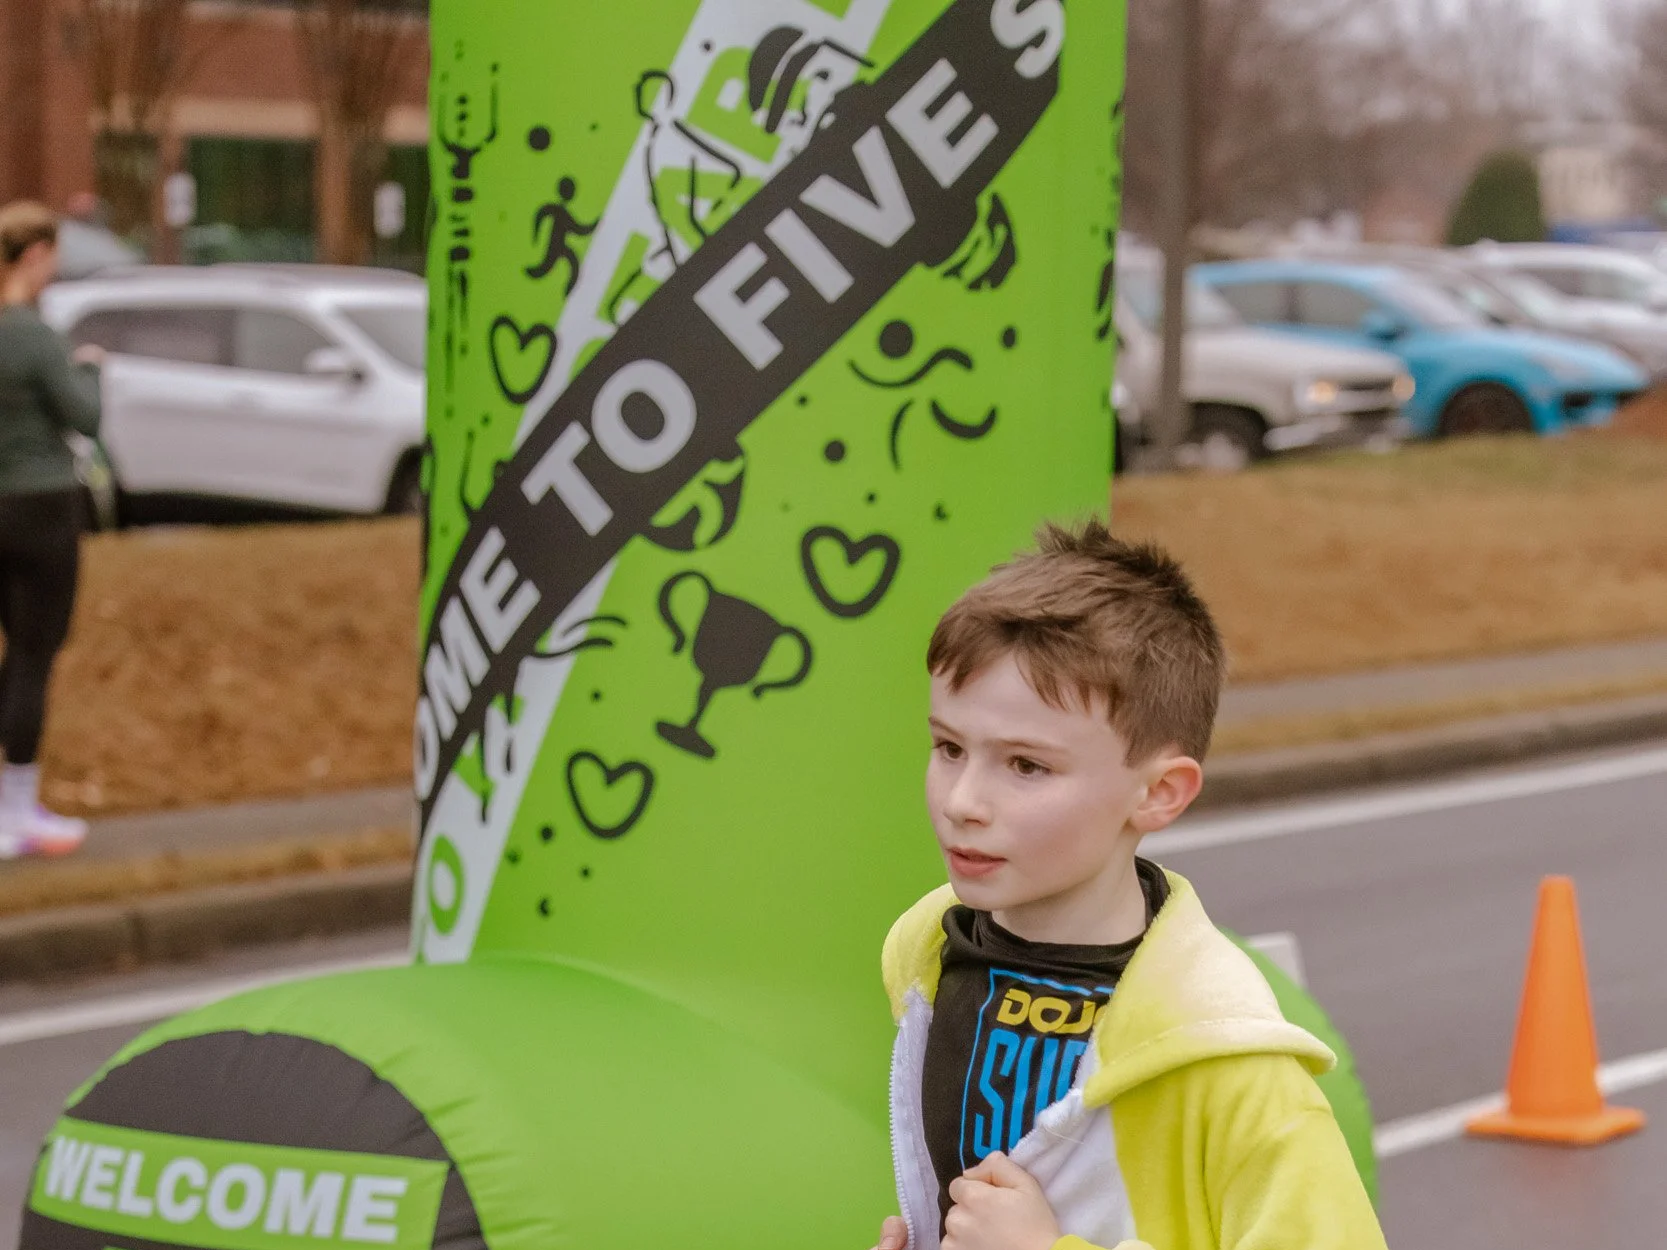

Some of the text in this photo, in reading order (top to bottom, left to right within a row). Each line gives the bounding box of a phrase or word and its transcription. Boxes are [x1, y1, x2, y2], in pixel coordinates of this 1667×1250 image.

[520, 358, 698, 538] TO
[692, 57, 1000, 371] FIVE
[996, 987, 1107, 1034] DOJ
[44, 1135, 409, 1245] WELCOME
